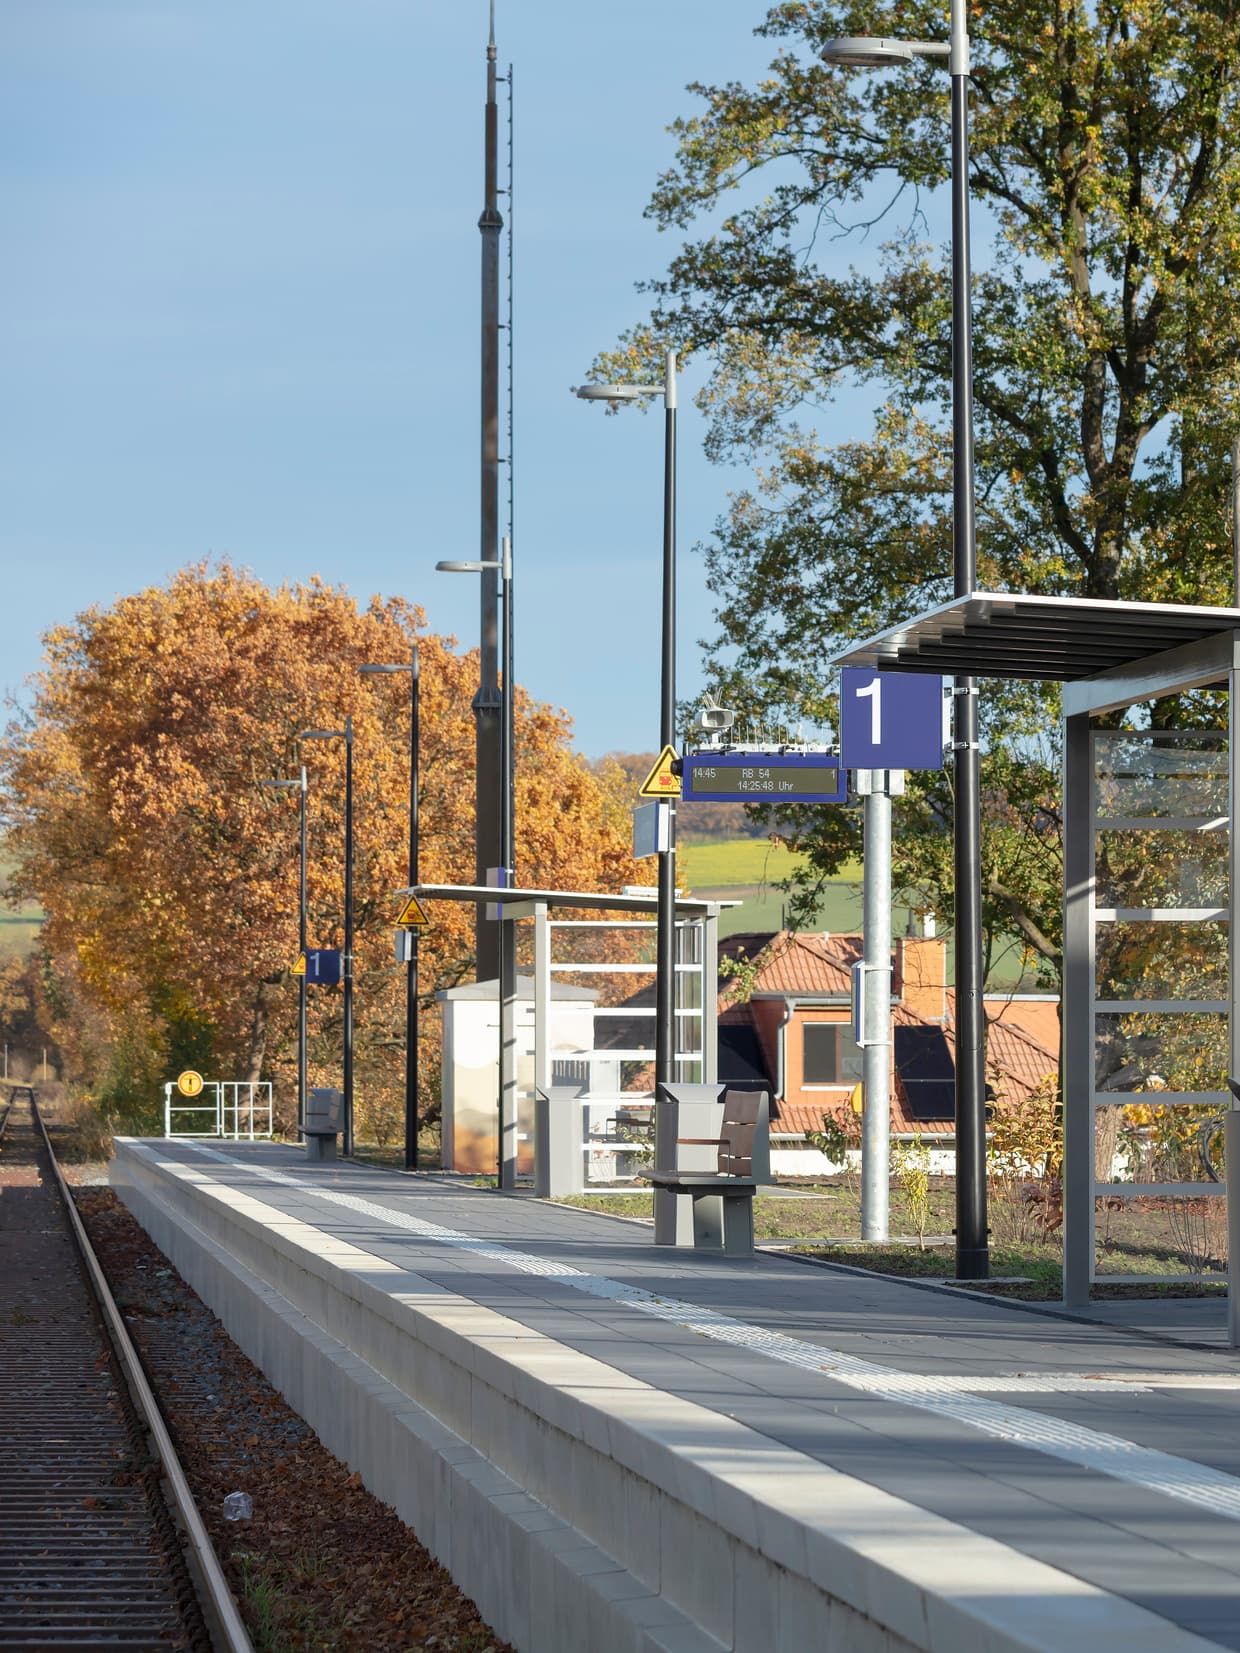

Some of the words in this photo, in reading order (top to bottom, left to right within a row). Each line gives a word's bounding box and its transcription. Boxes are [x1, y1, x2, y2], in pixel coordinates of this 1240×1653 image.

[856, 678, 881, 745] 1
[693, 768, 717, 778] 14:45
[742, 768, 754, 779] RB
[758, 768, 770, 779] 54
[737, 780, 774, 791] 14:25:48
[778, 781, 795, 791] Uhr
[310, 952, 320, 976] 1
